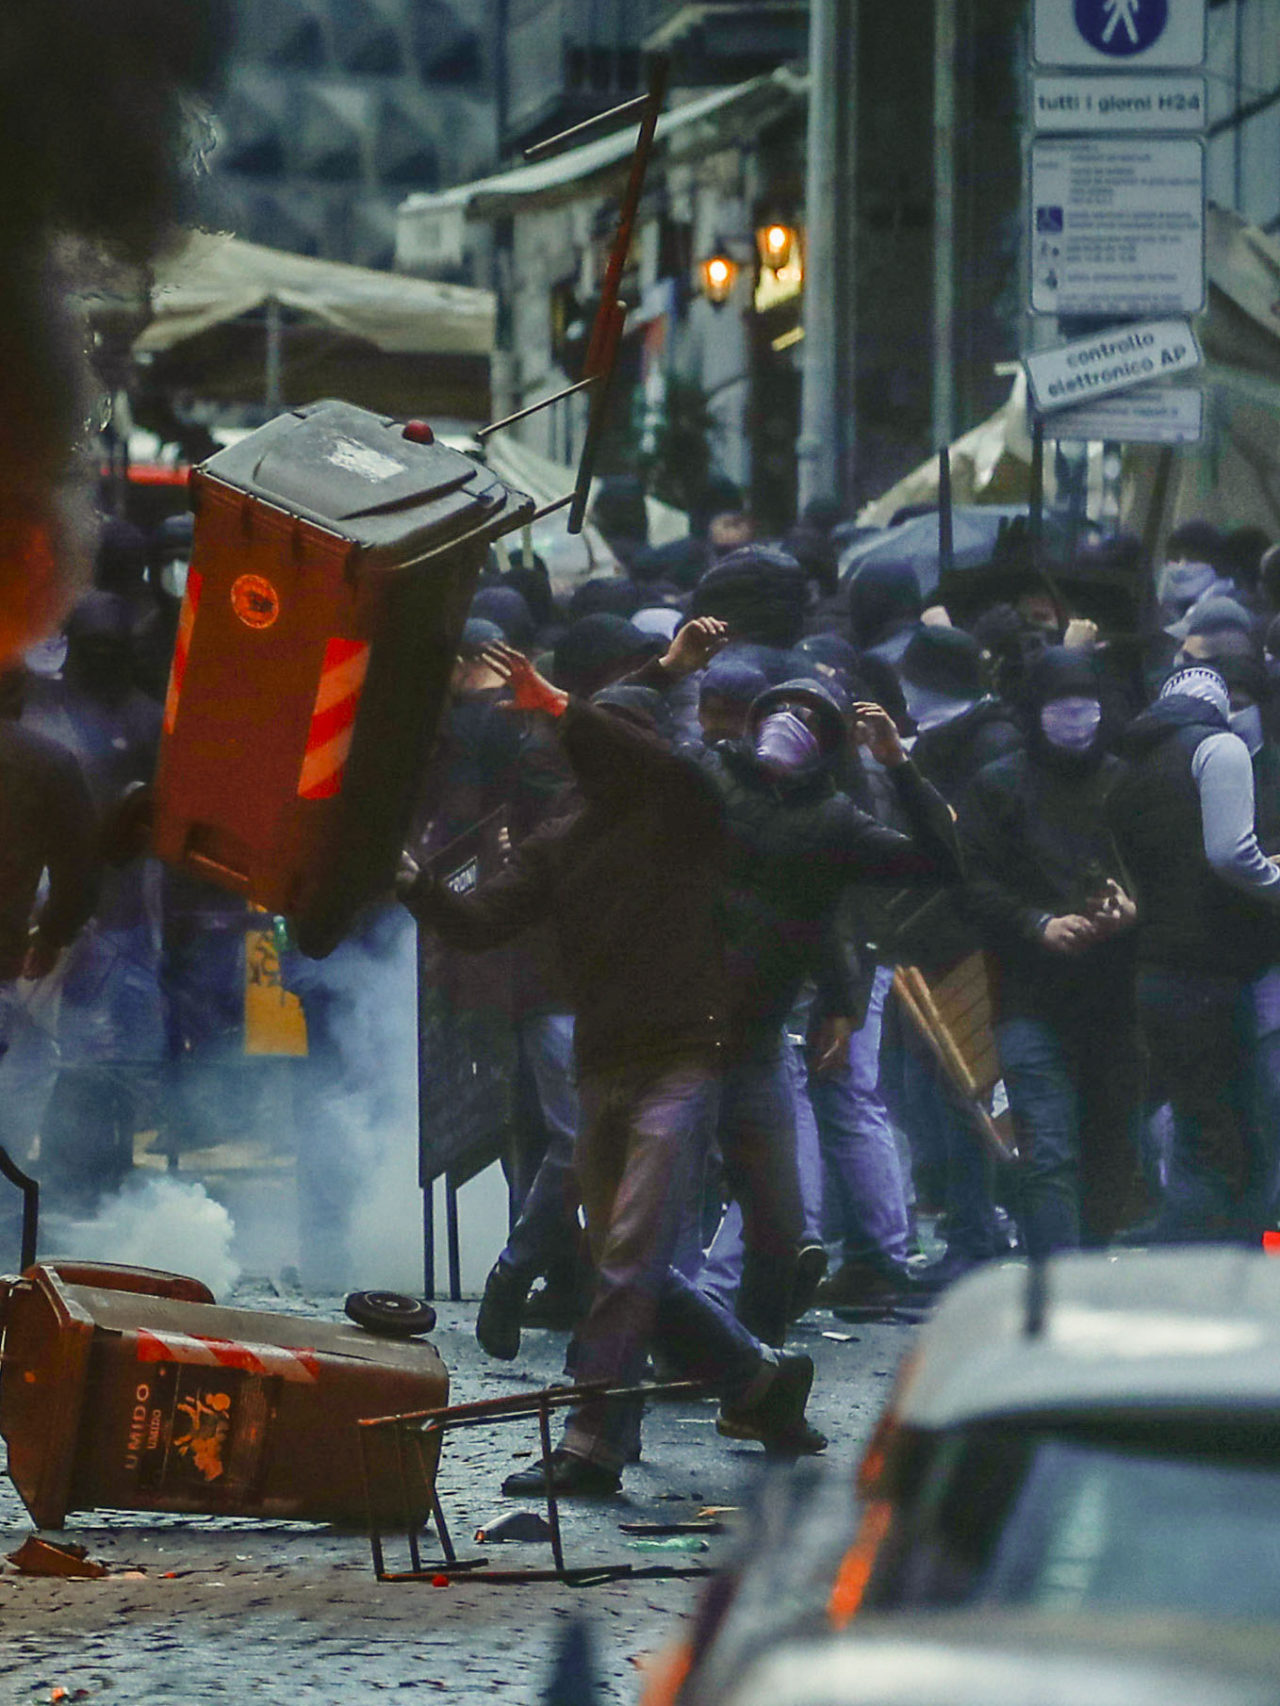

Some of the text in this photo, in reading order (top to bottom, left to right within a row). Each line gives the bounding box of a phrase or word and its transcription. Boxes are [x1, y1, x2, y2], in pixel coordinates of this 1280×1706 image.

[1038, 93, 1080, 110] tutti
[1098, 94, 1152, 114] giorni
[1158, 92, 1200, 110] H24
[1047, 343, 1187, 398] elettronico AP
[1066, 332, 1155, 369] controllo
[123, 1383, 150, 1470] UMIDO
